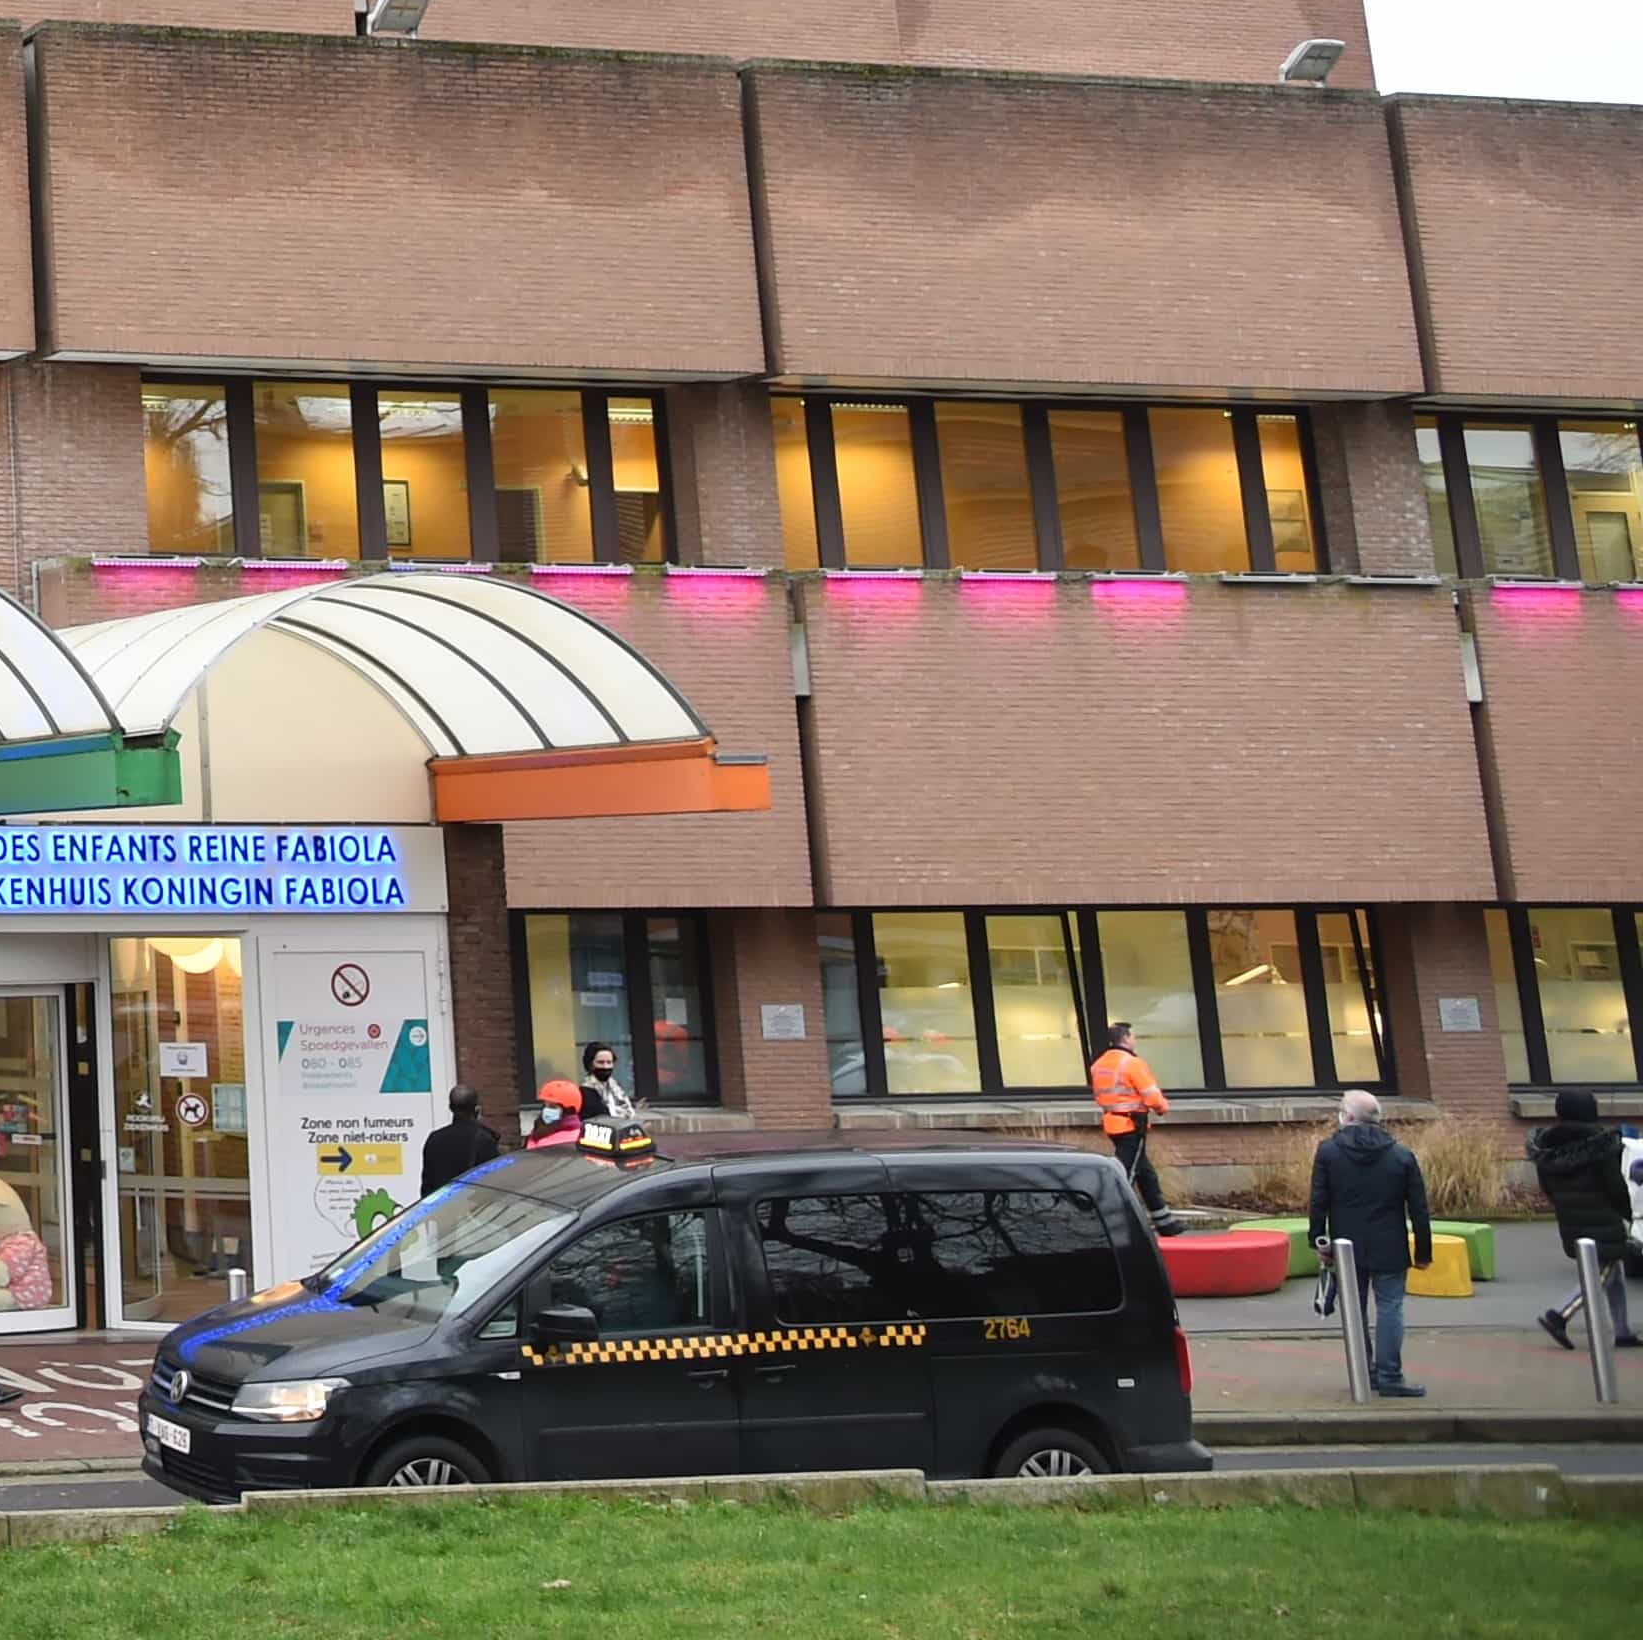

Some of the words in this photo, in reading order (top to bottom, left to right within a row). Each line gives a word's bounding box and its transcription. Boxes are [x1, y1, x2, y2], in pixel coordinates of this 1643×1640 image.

[53, 834, 177, 862] ENFANTS
[189, 835, 265, 861] REINE
[277, 835, 396, 862] FABIOLA
[124, 877, 273, 905] KONINGIN
[287, 877, 405, 906] FABIOLA
[299, 1024, 356, 1037] Urgences
[299, 1040, 389, 1053] Spoedgevallen
[301, 1117, 333, 1130] Zone
[336, 1119, 360, 1129] non
[364, 1117, 414, 1129] fumeurs
[308, 1132, 340, 1144] Zone
[343, 1131, 409, 1143] niet-rokers
[983, 1316, 1031, 1340] 2764
